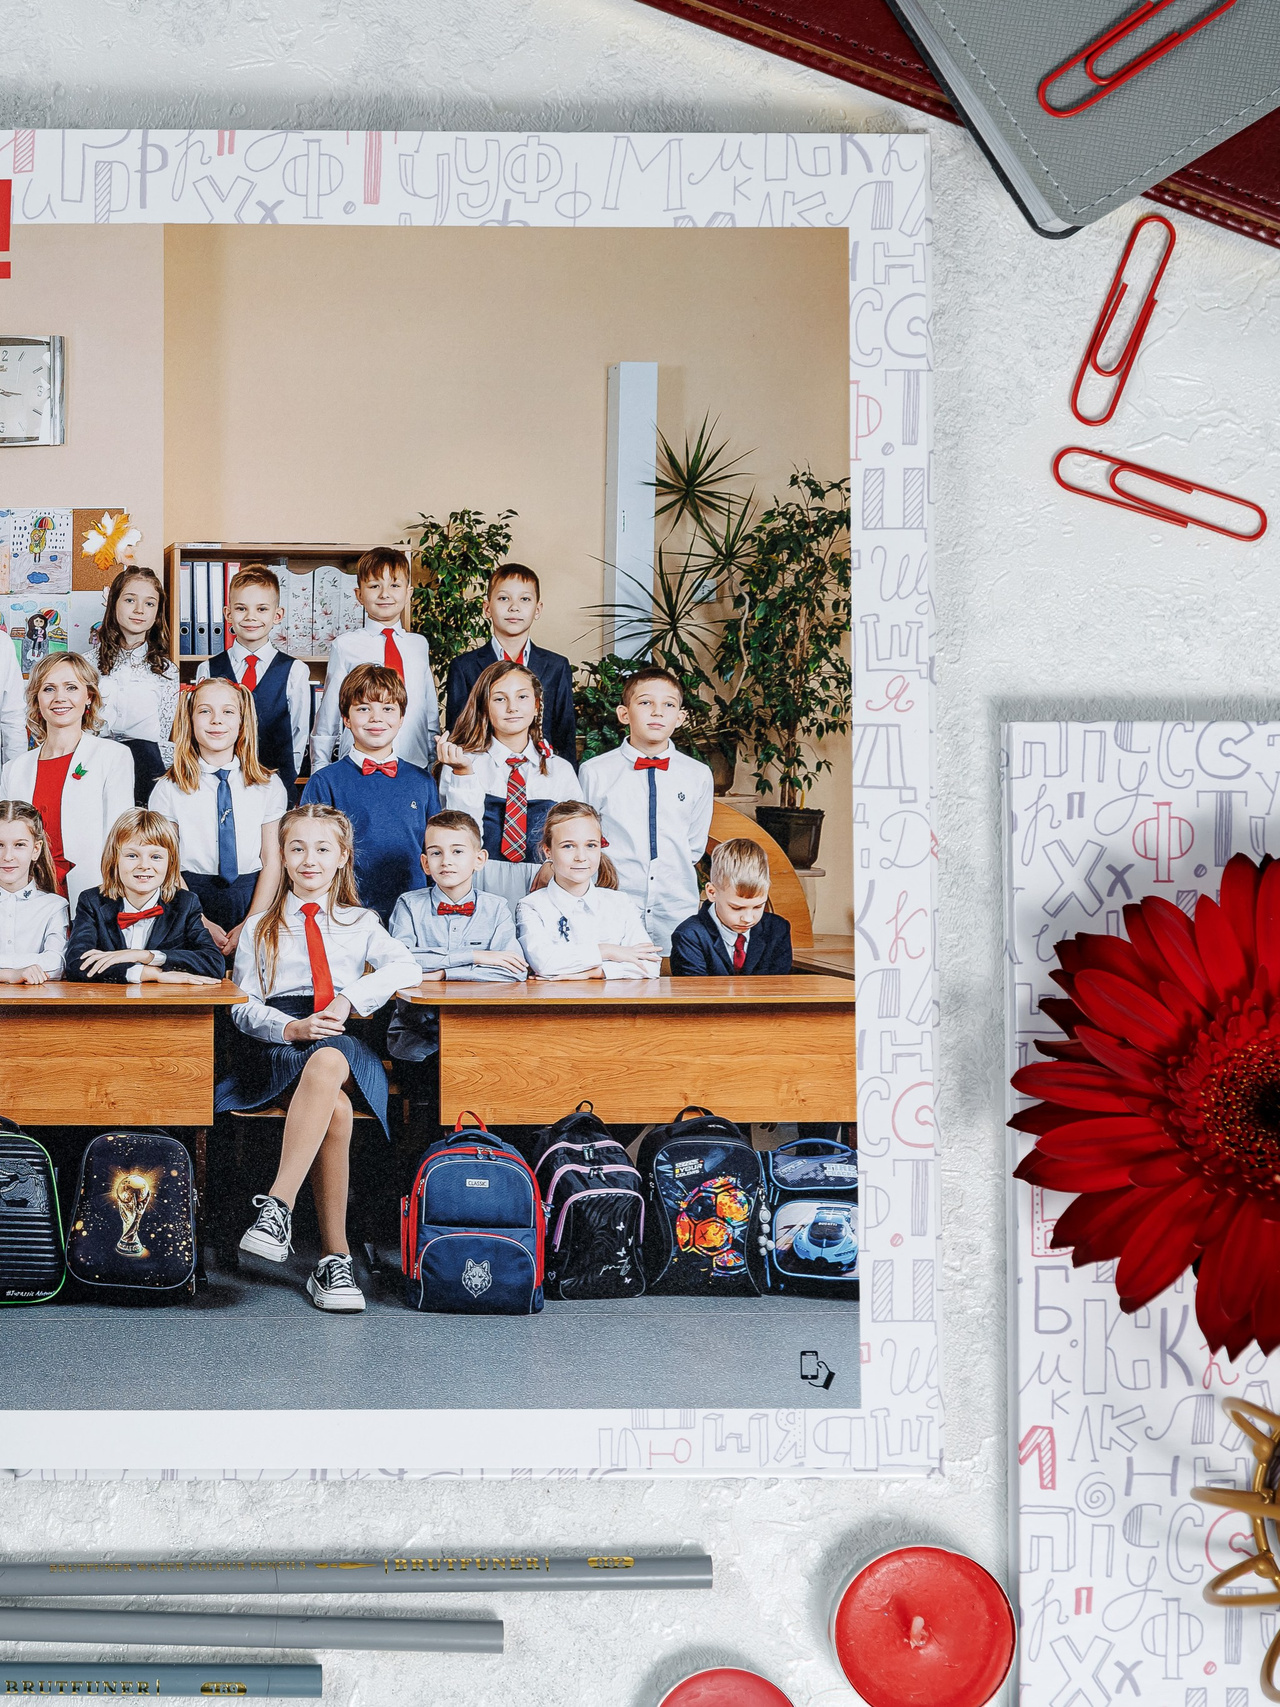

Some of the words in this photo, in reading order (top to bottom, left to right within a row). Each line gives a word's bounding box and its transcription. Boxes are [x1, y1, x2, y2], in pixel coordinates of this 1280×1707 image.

[680, 1163, 703, 1172] YOUR
[49, 1562, 132, 1574] BRUTFUNER
[137, 1561, 184, 1573] WATER
[189, 1561, 246, 1572] COLOUR
[250, 1560, 306, 1571] PENCILS
